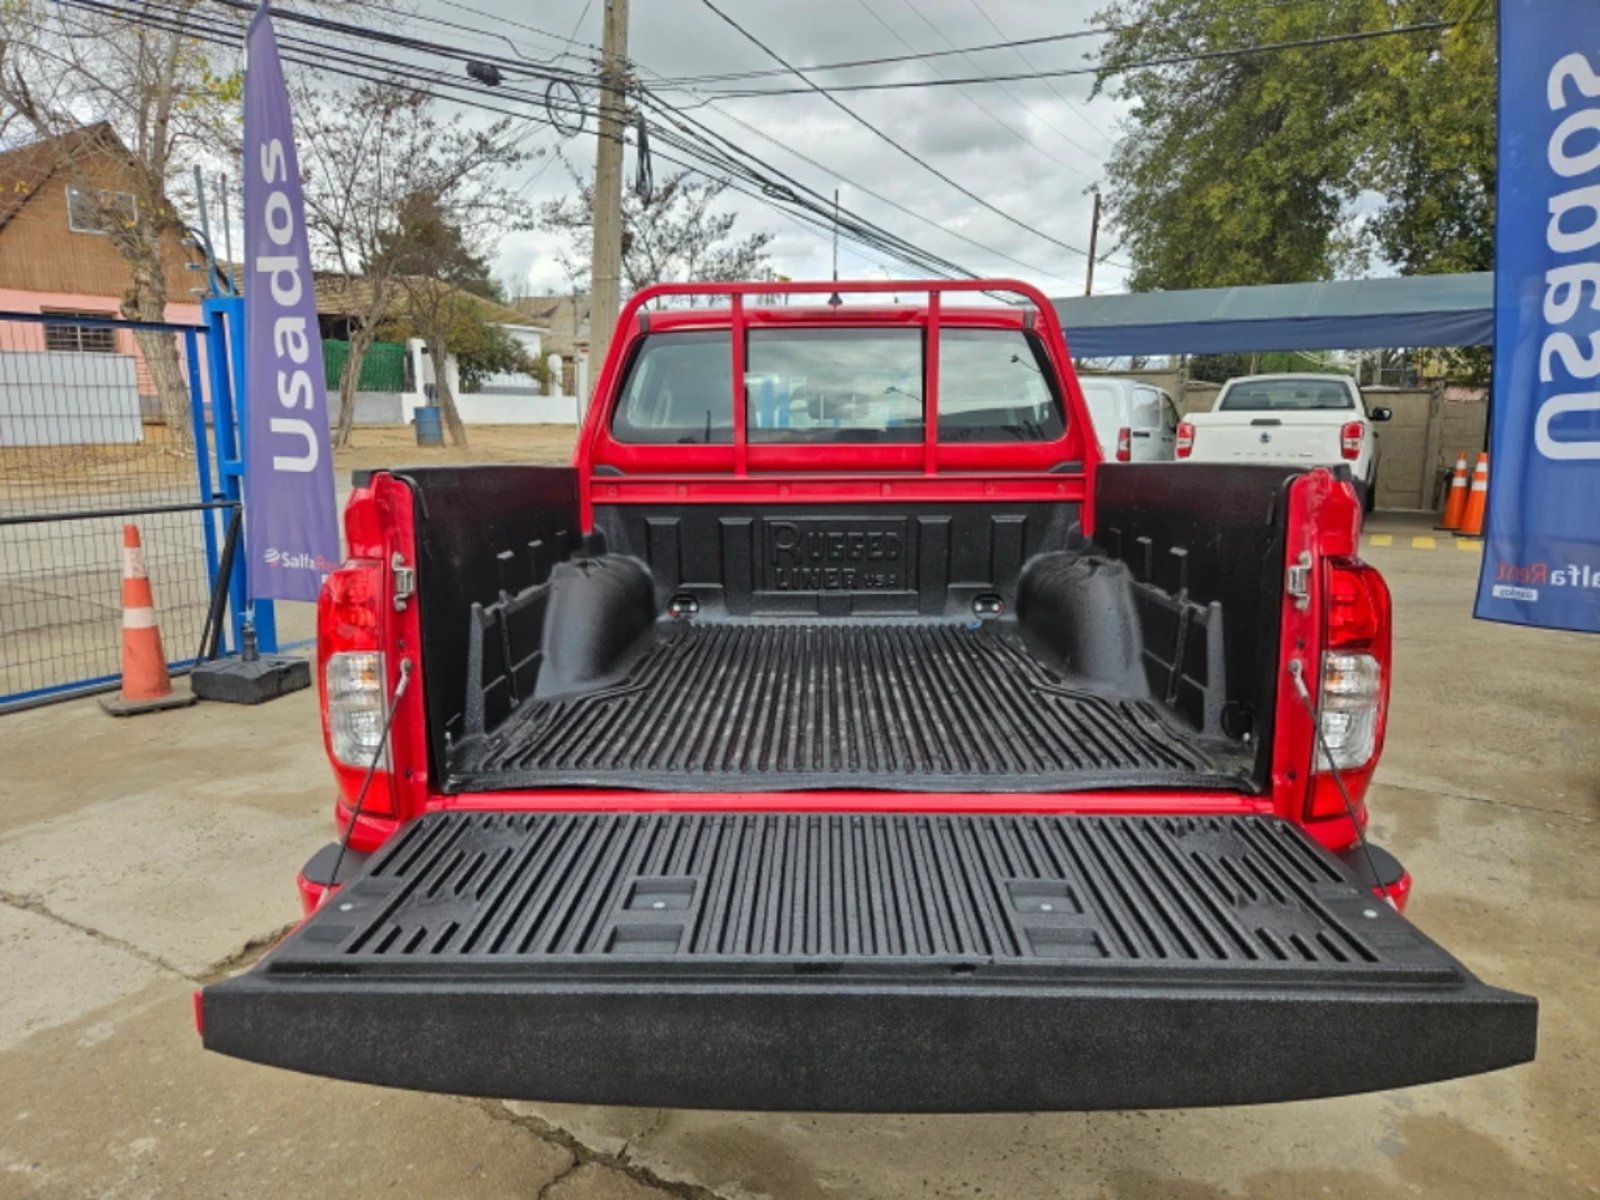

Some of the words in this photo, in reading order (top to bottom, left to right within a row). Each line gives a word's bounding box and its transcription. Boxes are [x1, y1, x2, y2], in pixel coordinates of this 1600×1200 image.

[256, 138, 319, 473] Usados
[769, 521, 899, 565] RUGGED
[775, 567, 857, 590] LINER
